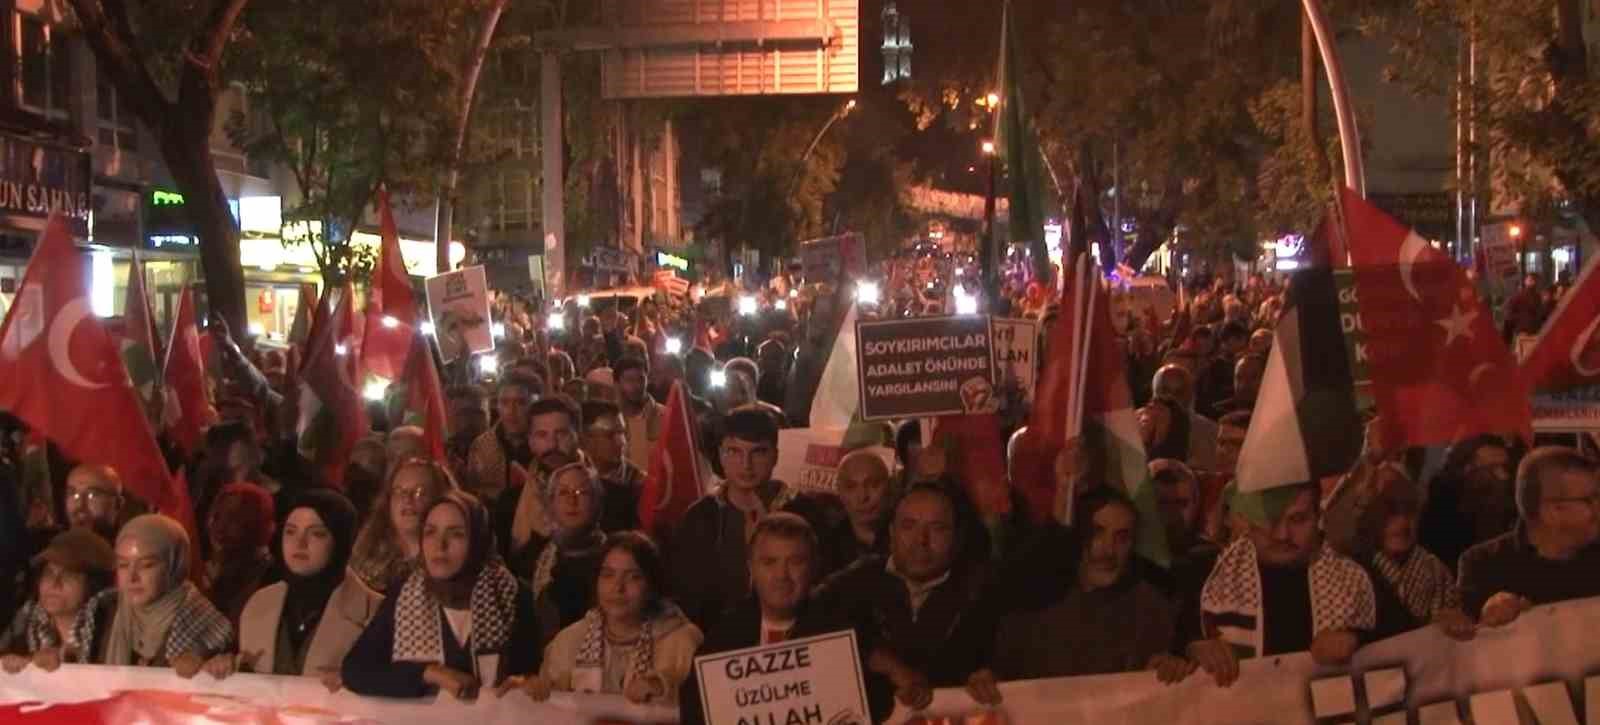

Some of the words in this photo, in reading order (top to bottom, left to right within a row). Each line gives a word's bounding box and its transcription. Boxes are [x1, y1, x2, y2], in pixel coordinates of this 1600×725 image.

[865, 334, 986, 356] SOYKIRIMCILAR
[866, 360, 924, 377] ADALET
[924, 355, 987, 372] ÖNÜNDE
[725, 646, 811, 680] GAZZE
[735, 680, 812, 707] ÜZÜLME
